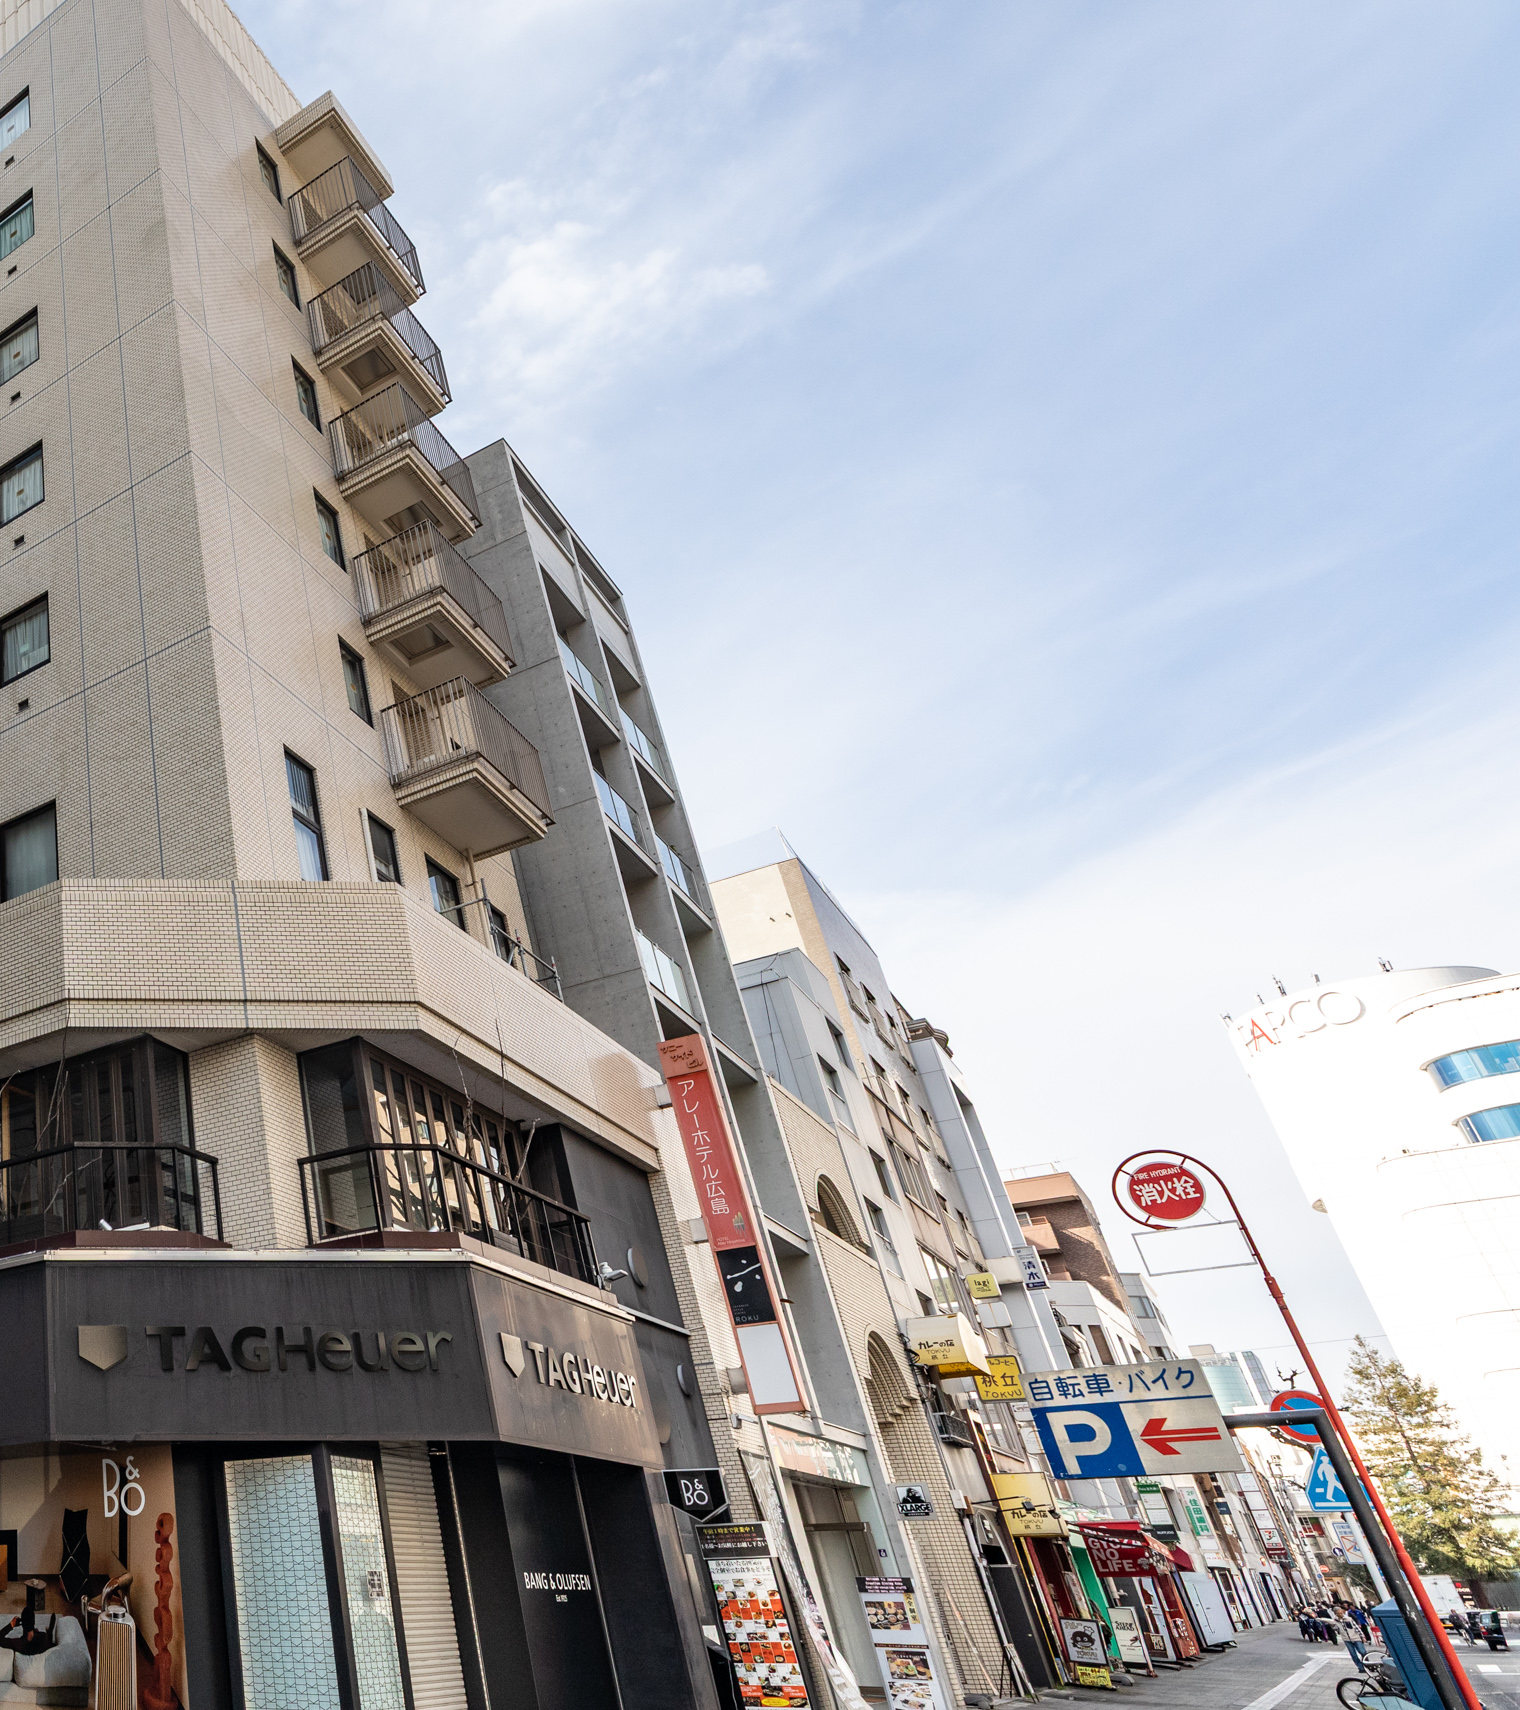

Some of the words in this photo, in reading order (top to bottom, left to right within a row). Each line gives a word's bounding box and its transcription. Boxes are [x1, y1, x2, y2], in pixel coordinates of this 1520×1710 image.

[677, 1079, 730, 1216] アレーホテル広島
[1133, 1172, 1150, 1181] FIRE
[1149, 1166, 1181, 1178] HYDRANT
[1132, 1175, 1201, 1207] 消火栓
[735, 1314, 759, 1323] ROKU
[917, 1339, 956, 1350] カレーの店
[980, 1372, 1018, 1387] 桃丘
[1028, 1366, 1196, 1402] 自転車・バイク
[1045, 1410, 1112, 1475] P
[900, 1503, 931, 1512] XLARGE
[1092, 1548, 1119, 1560] NO
[1096, 1559, 1136, 1572] LIFE
[523, 1571, 549, 1590] BANG
[549, 1573, 556, 1590] &
[556, 1573, 592, 1591] OLUFSEN
